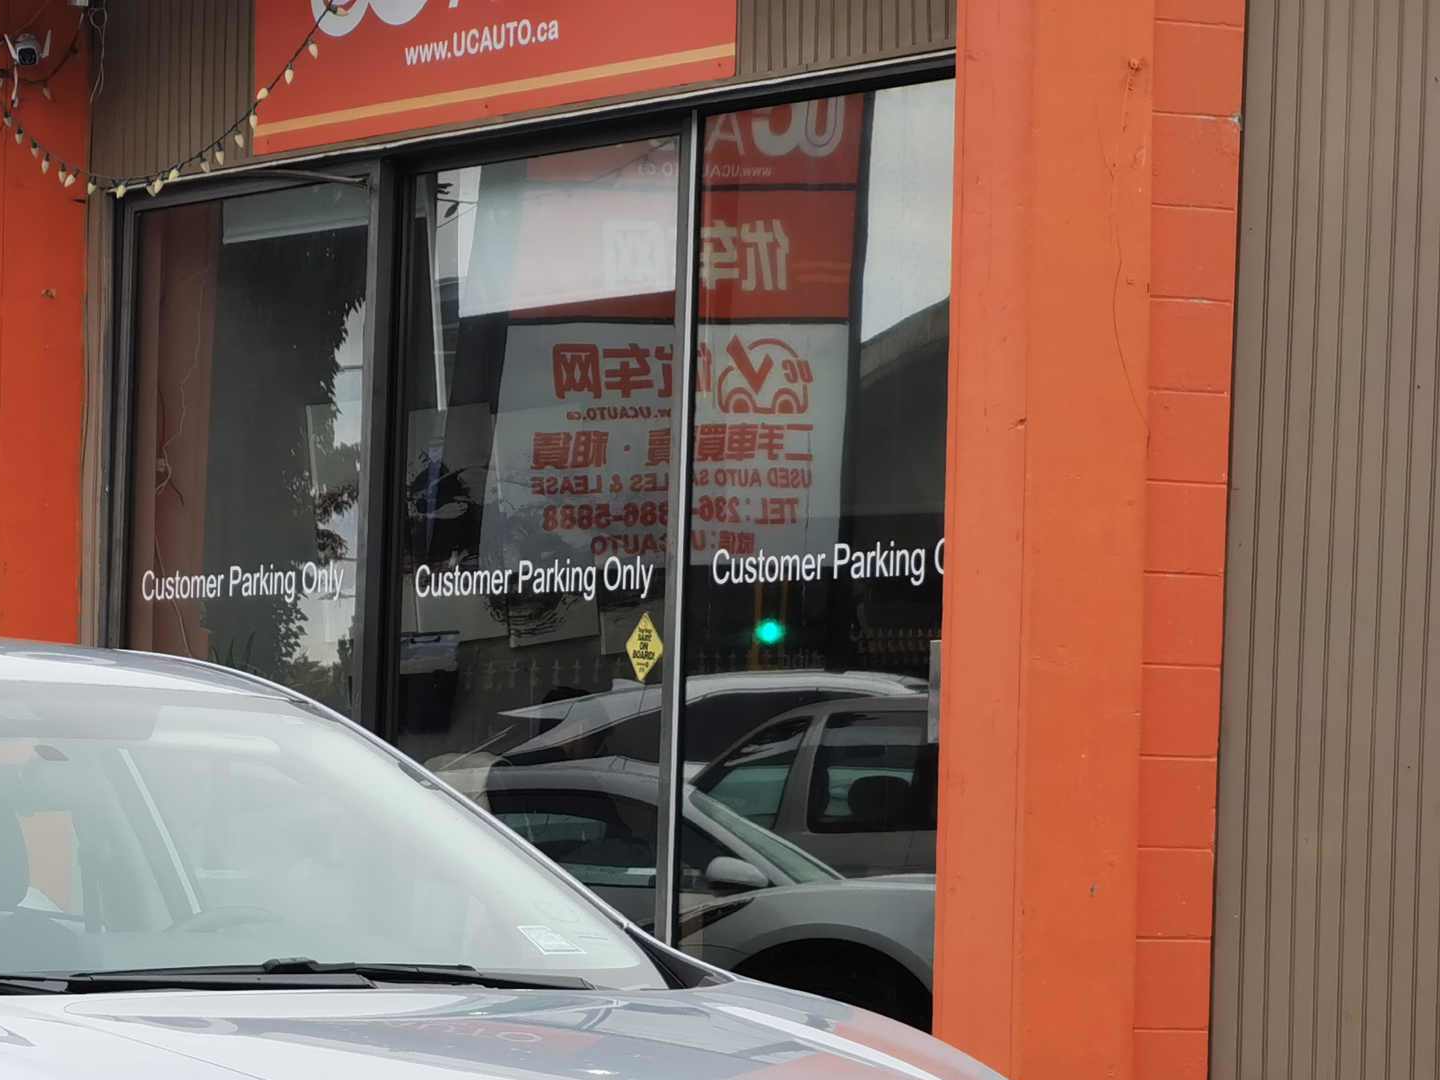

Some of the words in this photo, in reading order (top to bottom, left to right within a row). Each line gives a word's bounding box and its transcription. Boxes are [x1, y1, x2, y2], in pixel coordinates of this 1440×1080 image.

[404, 18, 560, 66] www.UCAUTO.ca
[141, 569, 225, 601] Customer
[228, 563, 296, 603] Parking
[301, 559, 344, 601] Only
[415, 564, 513, 598] Customer
[517, 558, 597, 601] Parking
[603, 555, 654, 599] Only
[712, 547, 826, 585] Customer
[832, 540, 926, 587] Parking
